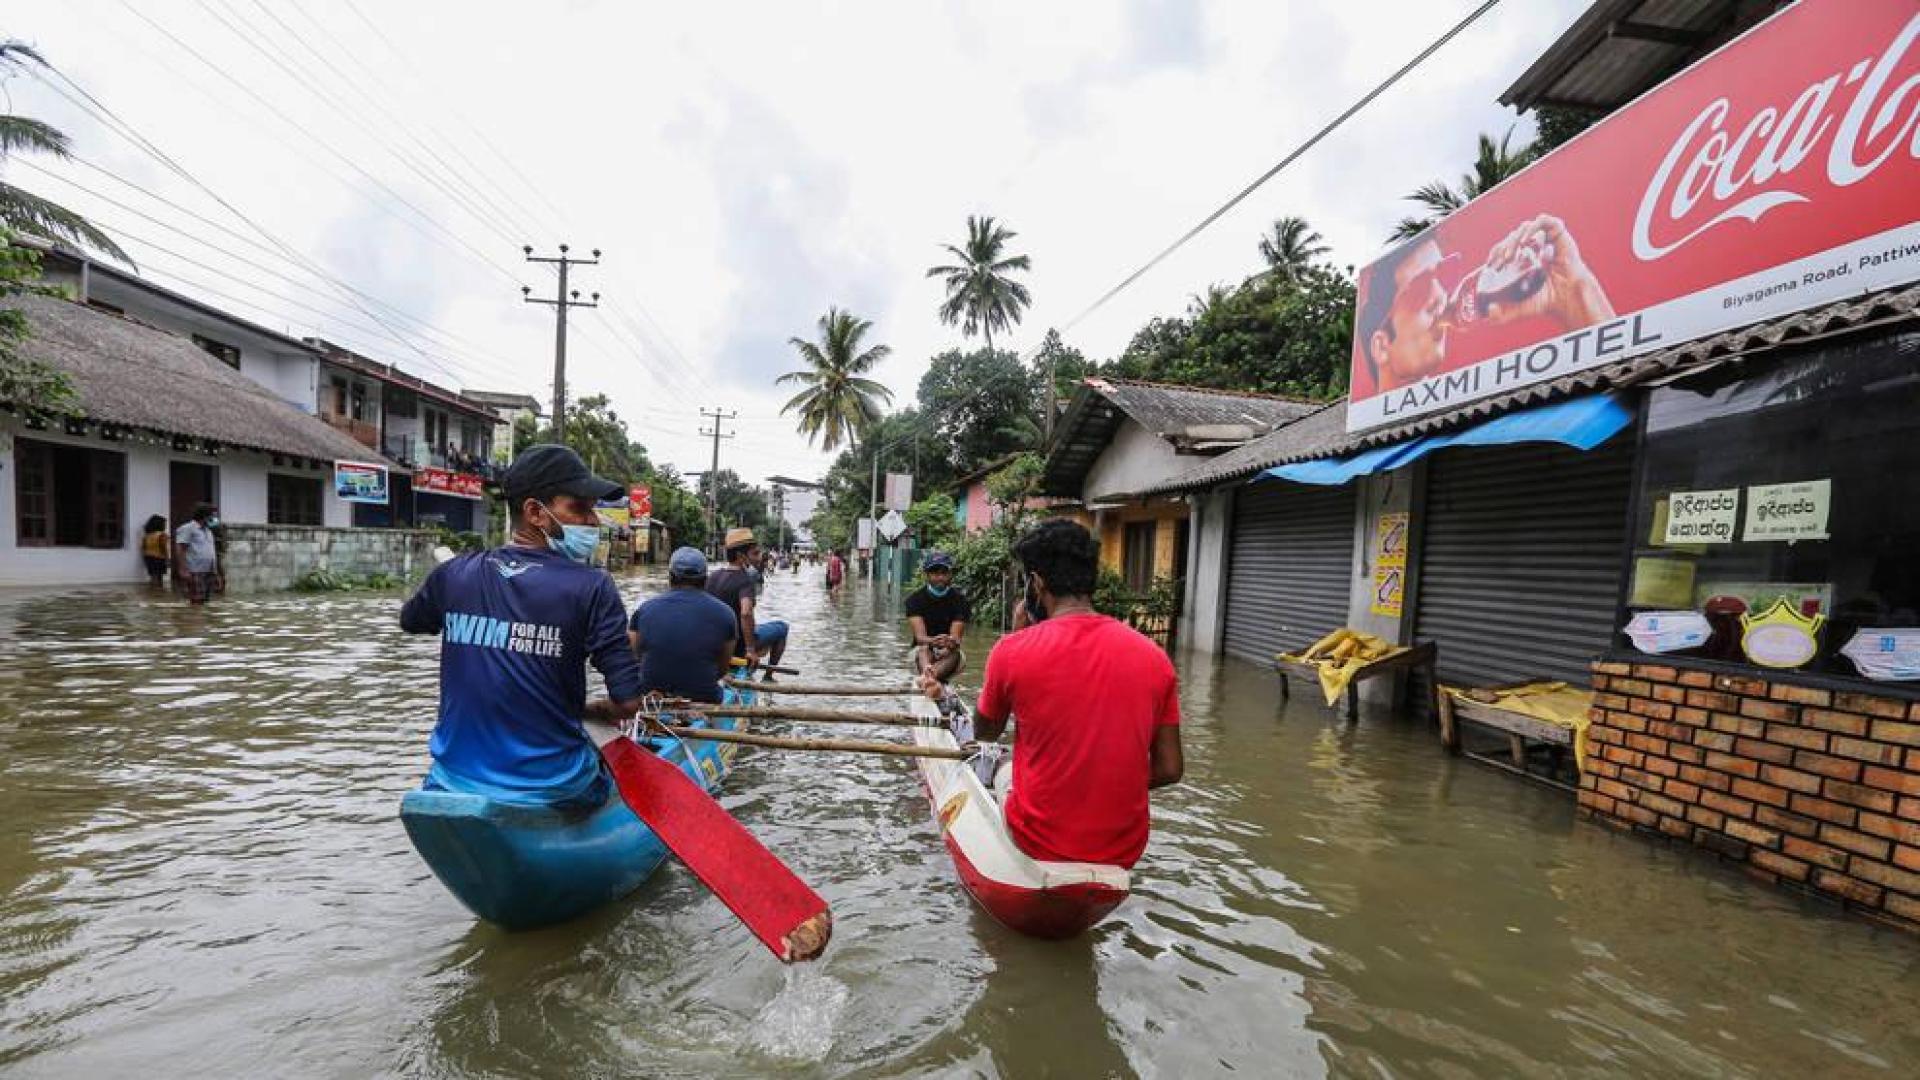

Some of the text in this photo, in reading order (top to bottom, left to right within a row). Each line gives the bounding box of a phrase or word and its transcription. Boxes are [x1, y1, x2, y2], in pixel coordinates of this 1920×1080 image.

[1633, 12, 1920, 260] Coca-C
[1723, 279, 1797, 309] Biyagama
[1802, 262, 1853, 286] Road,
[1382, 314, 1661, 416] LAXMI HOTEL
[508, 637, 563, 657] FOR LIFE
[511, 621, 561, 641] FOR ALL
